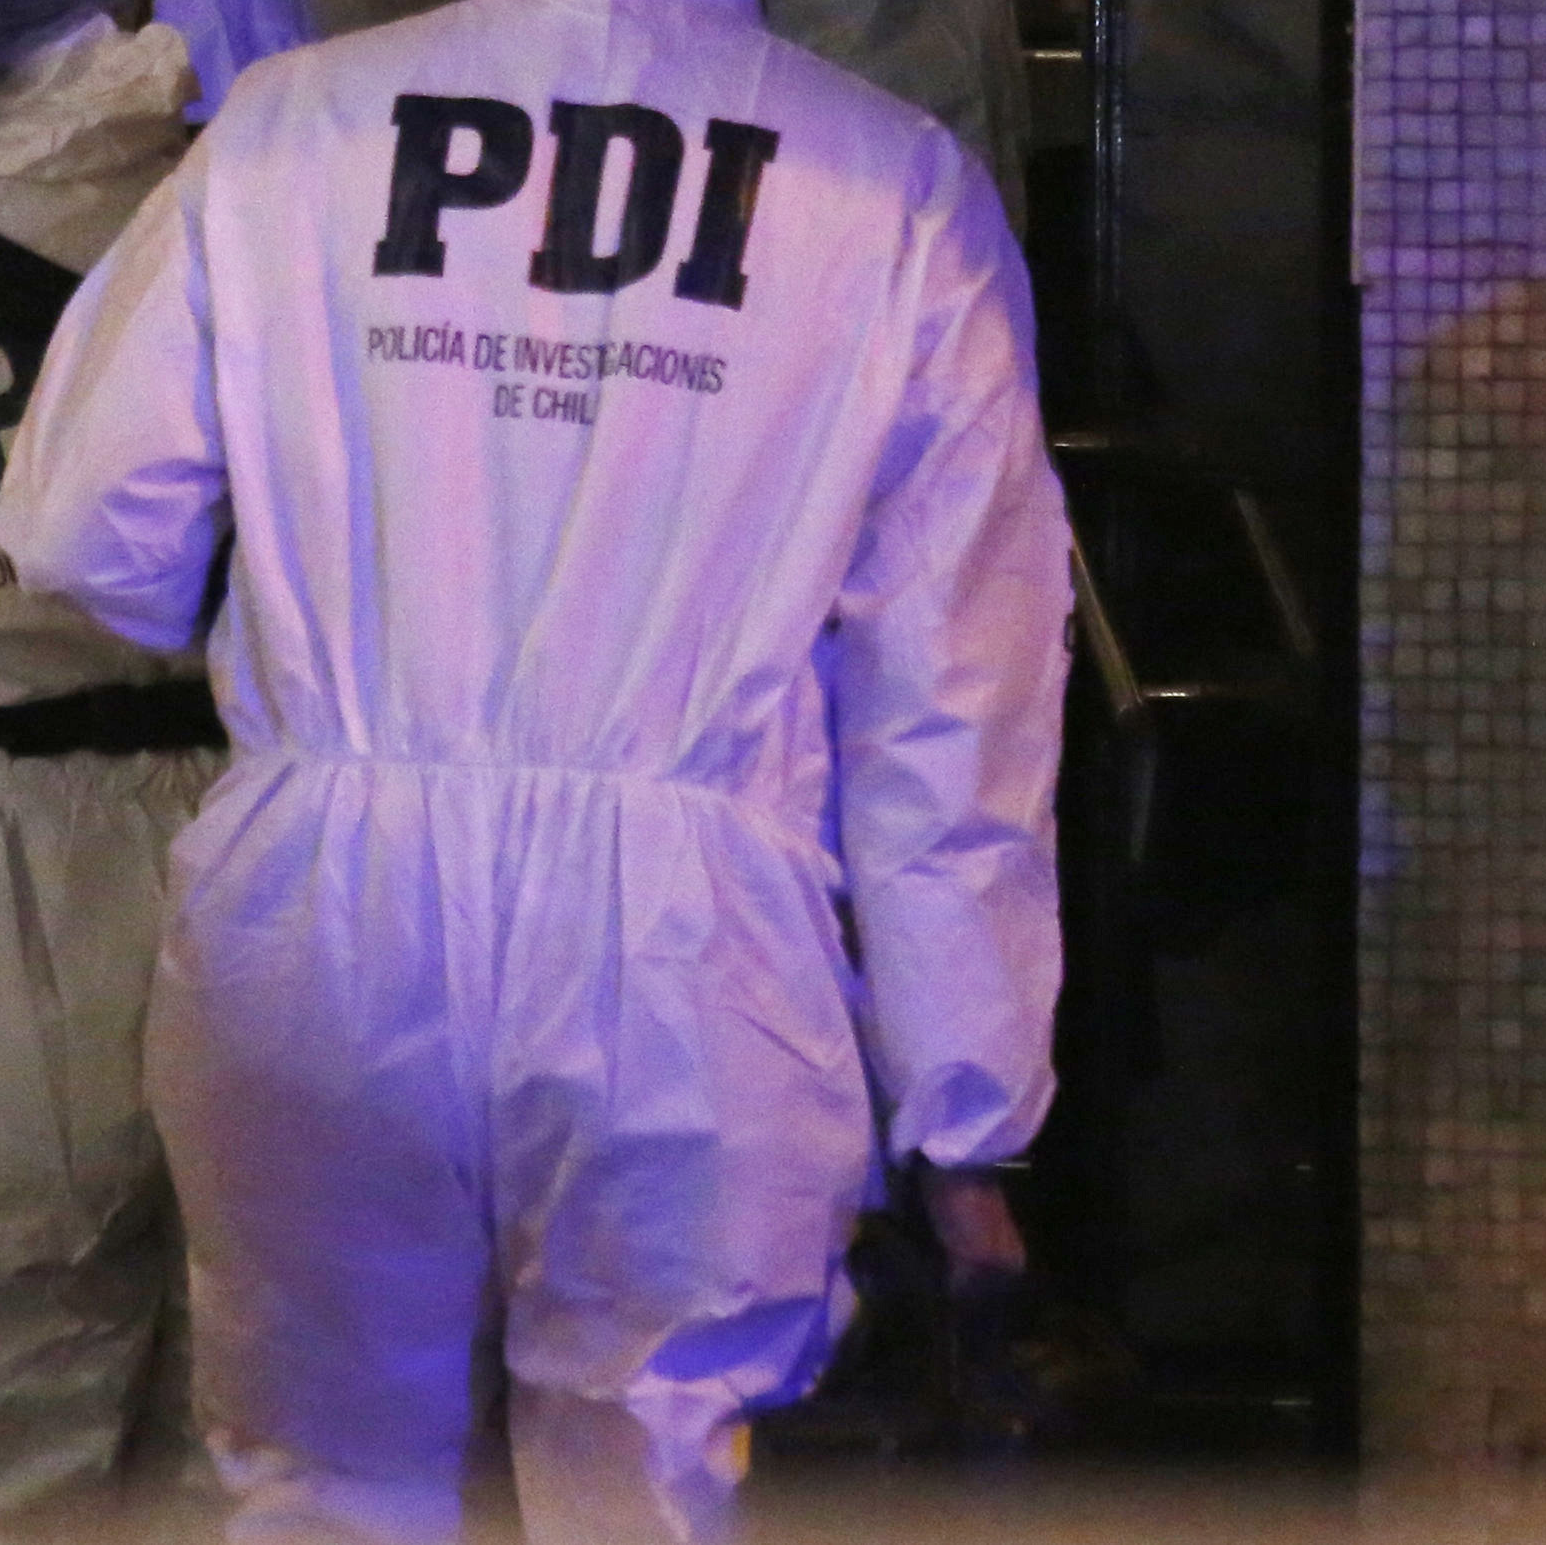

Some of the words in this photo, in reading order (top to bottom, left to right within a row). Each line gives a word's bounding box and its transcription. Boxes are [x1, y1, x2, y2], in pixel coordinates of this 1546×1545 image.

[373, 94, 780, 311] PDI
[368, 320, 465, 368] POLICÍA
[473, 333, 507, 371] DE
[493, 384, 525, 418] DE
[532, 386, 600, 425] CHIL
